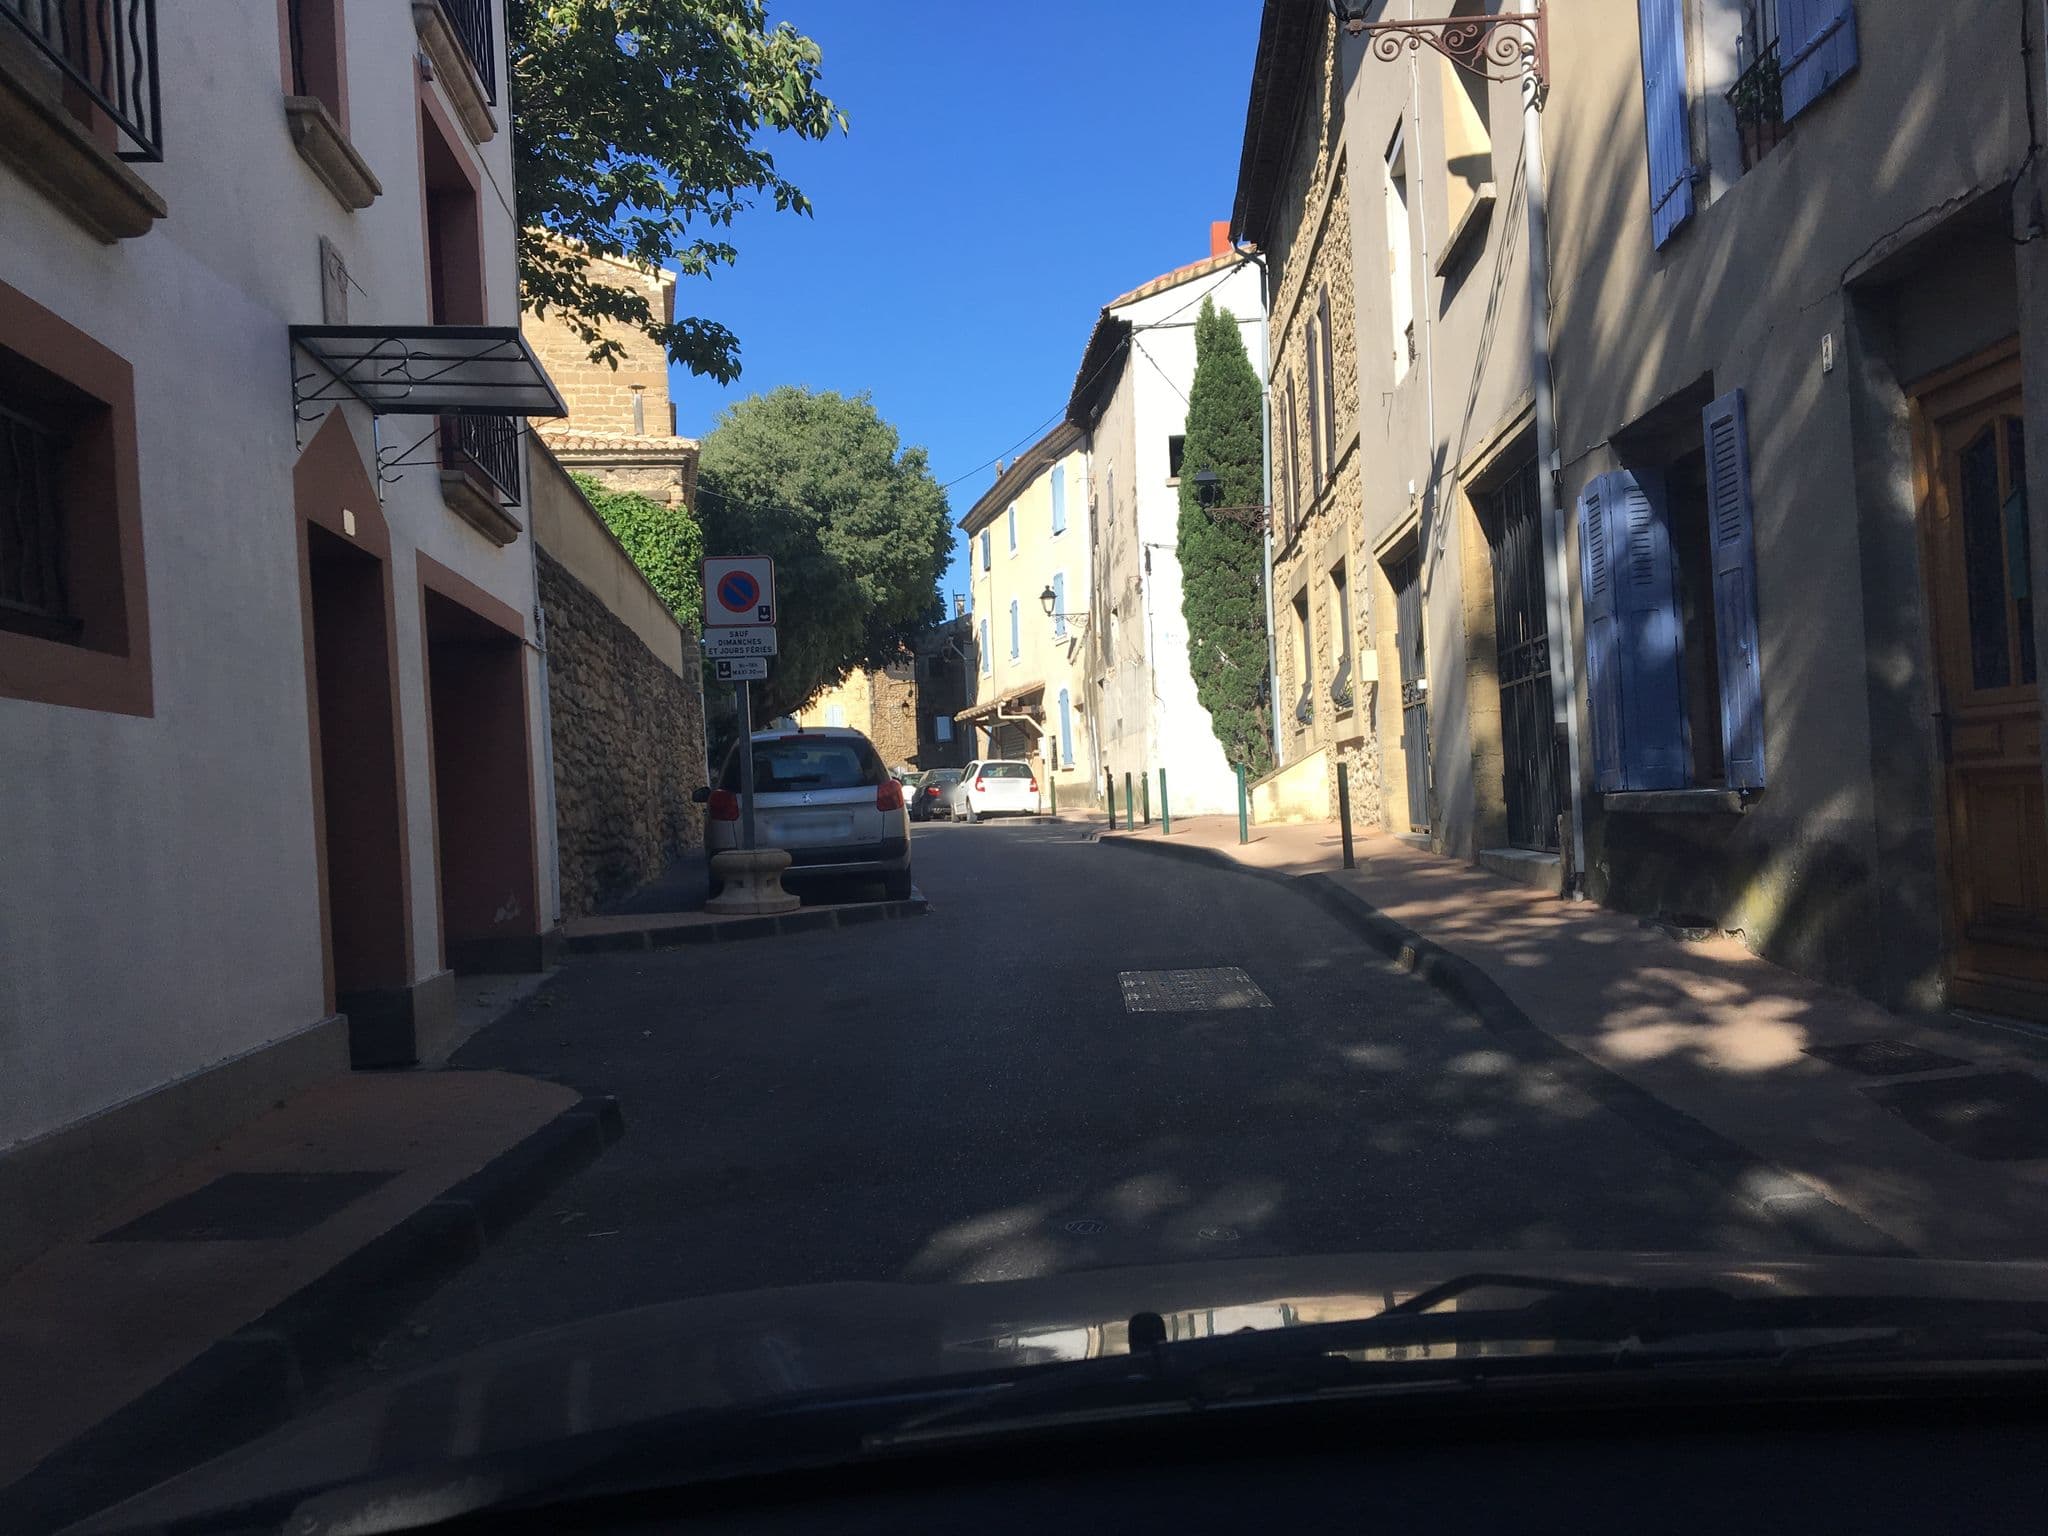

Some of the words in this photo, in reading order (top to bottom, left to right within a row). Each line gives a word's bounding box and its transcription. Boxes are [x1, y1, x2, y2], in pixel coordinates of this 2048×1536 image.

[718, 638, 762, 646] DIMANCHES
[708, 647, 718, 655] ET
[720, 646, 744, 655] JOURS
